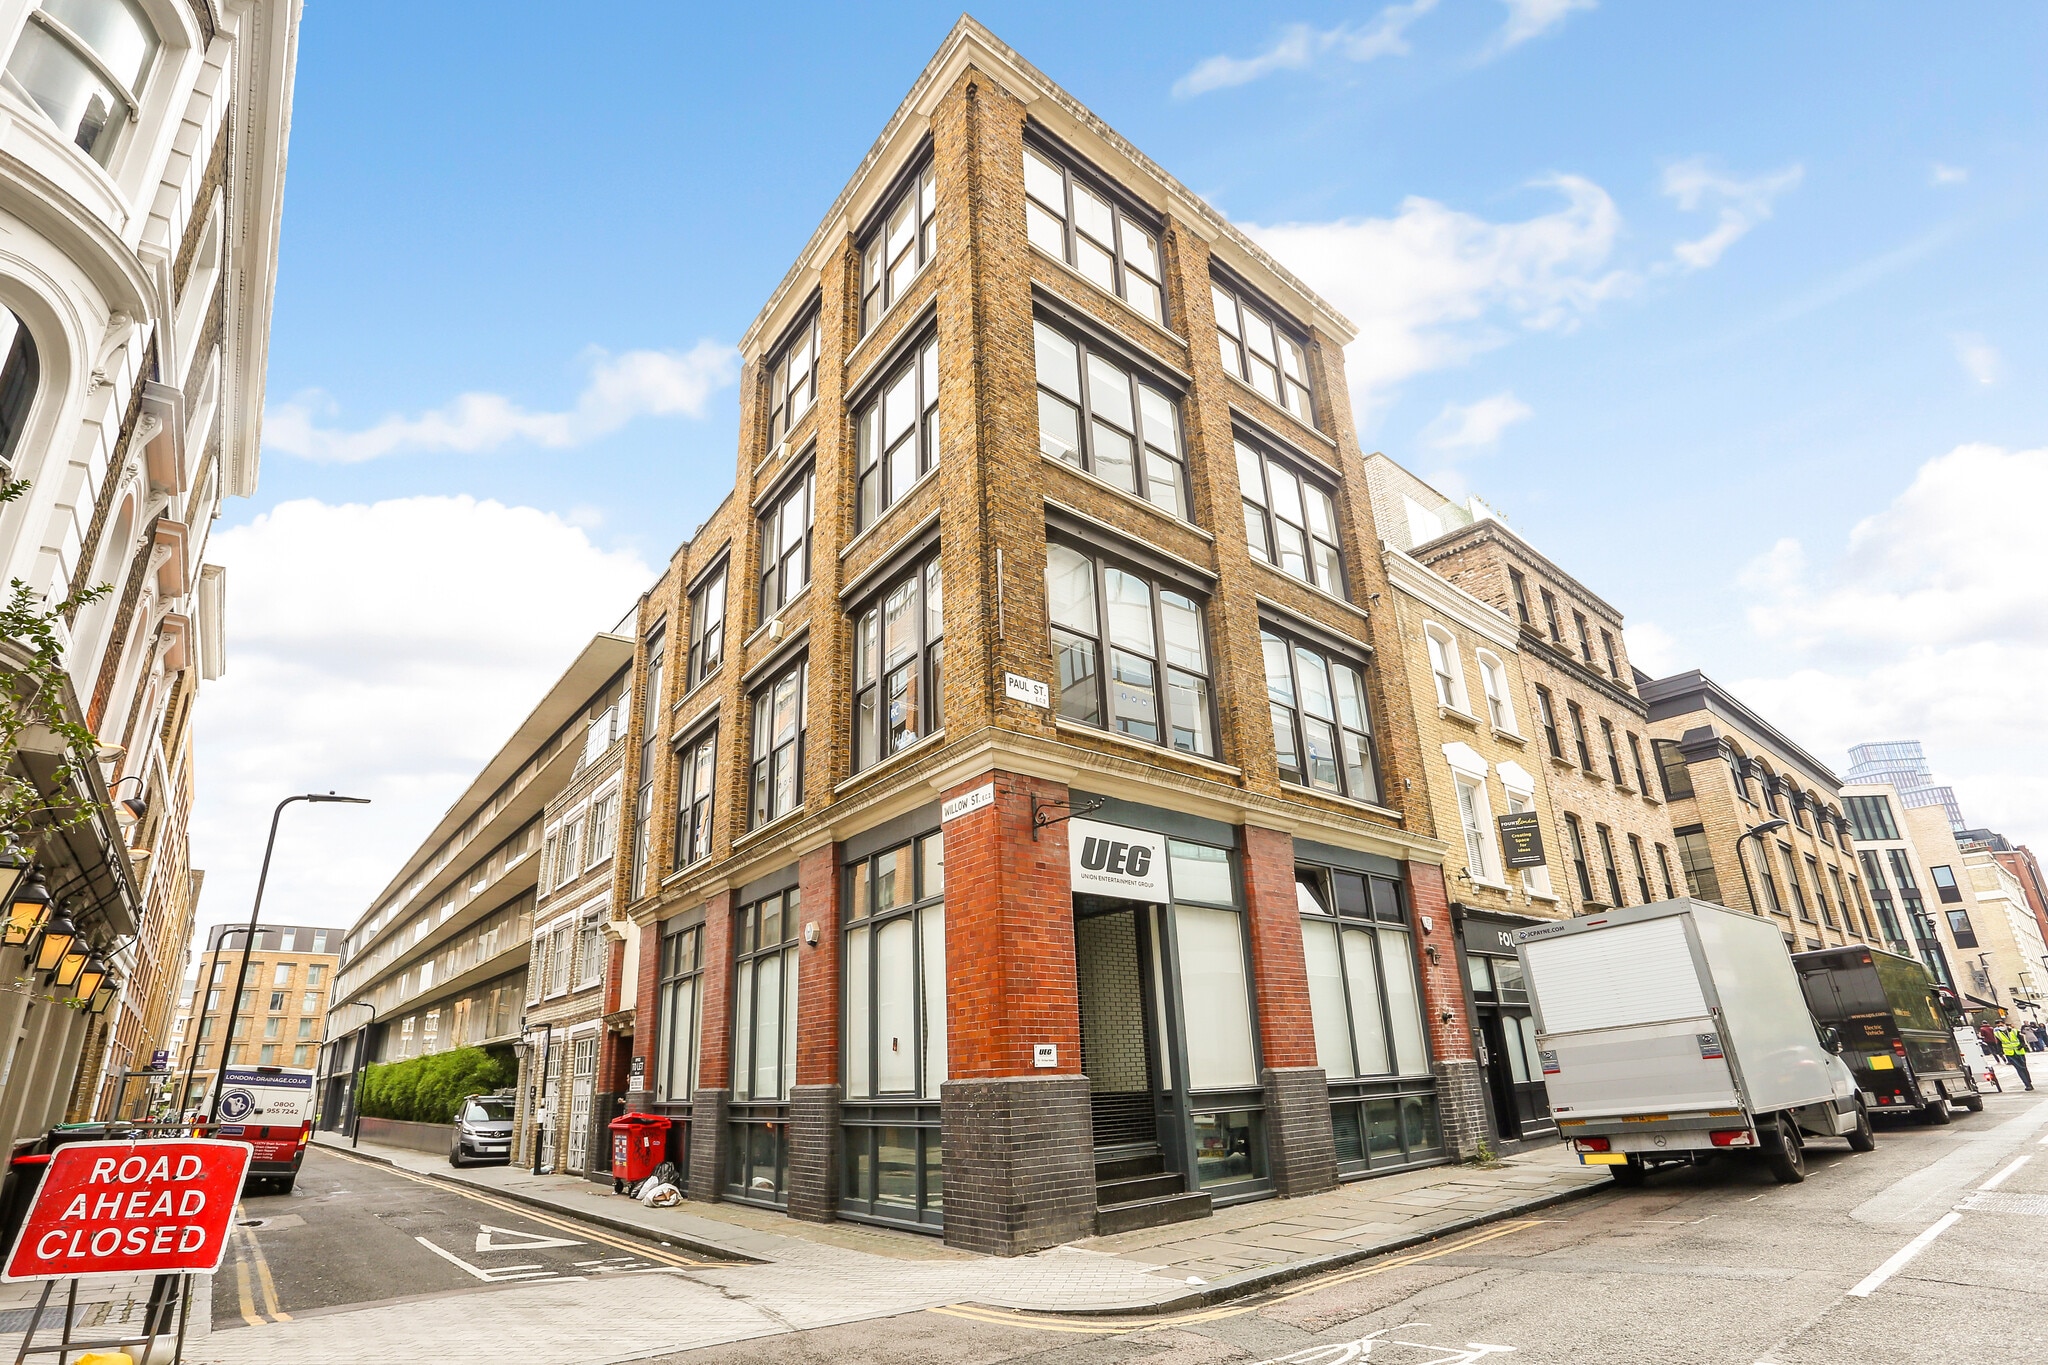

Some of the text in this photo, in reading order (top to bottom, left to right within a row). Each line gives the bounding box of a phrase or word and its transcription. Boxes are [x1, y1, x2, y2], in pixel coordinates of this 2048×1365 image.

[1008, 677, 1046, 697] PAUL ST.
[944, 797, 969, 817] WILLOW
[970, 793, 981, 806] ST.
[1081, 836, 1152, 877] UEG
[1080, 873, 1098, 881] UNION
[1098, 875, 1137, 886] ENTERTAINMENT
[1527, 925, 1565, 938] JCPAYNE.COM
[1850, 1011, 1888, 1019] www.ups.com
[225, 1074, 307, 1084] LONDON-DRAINAGE.CO.UK
[89, 1155, 201, 1184] ROAD
[60, 1190, 206, 1221] AHEAD
[36, 1225, 206, 1260] CLOSED
